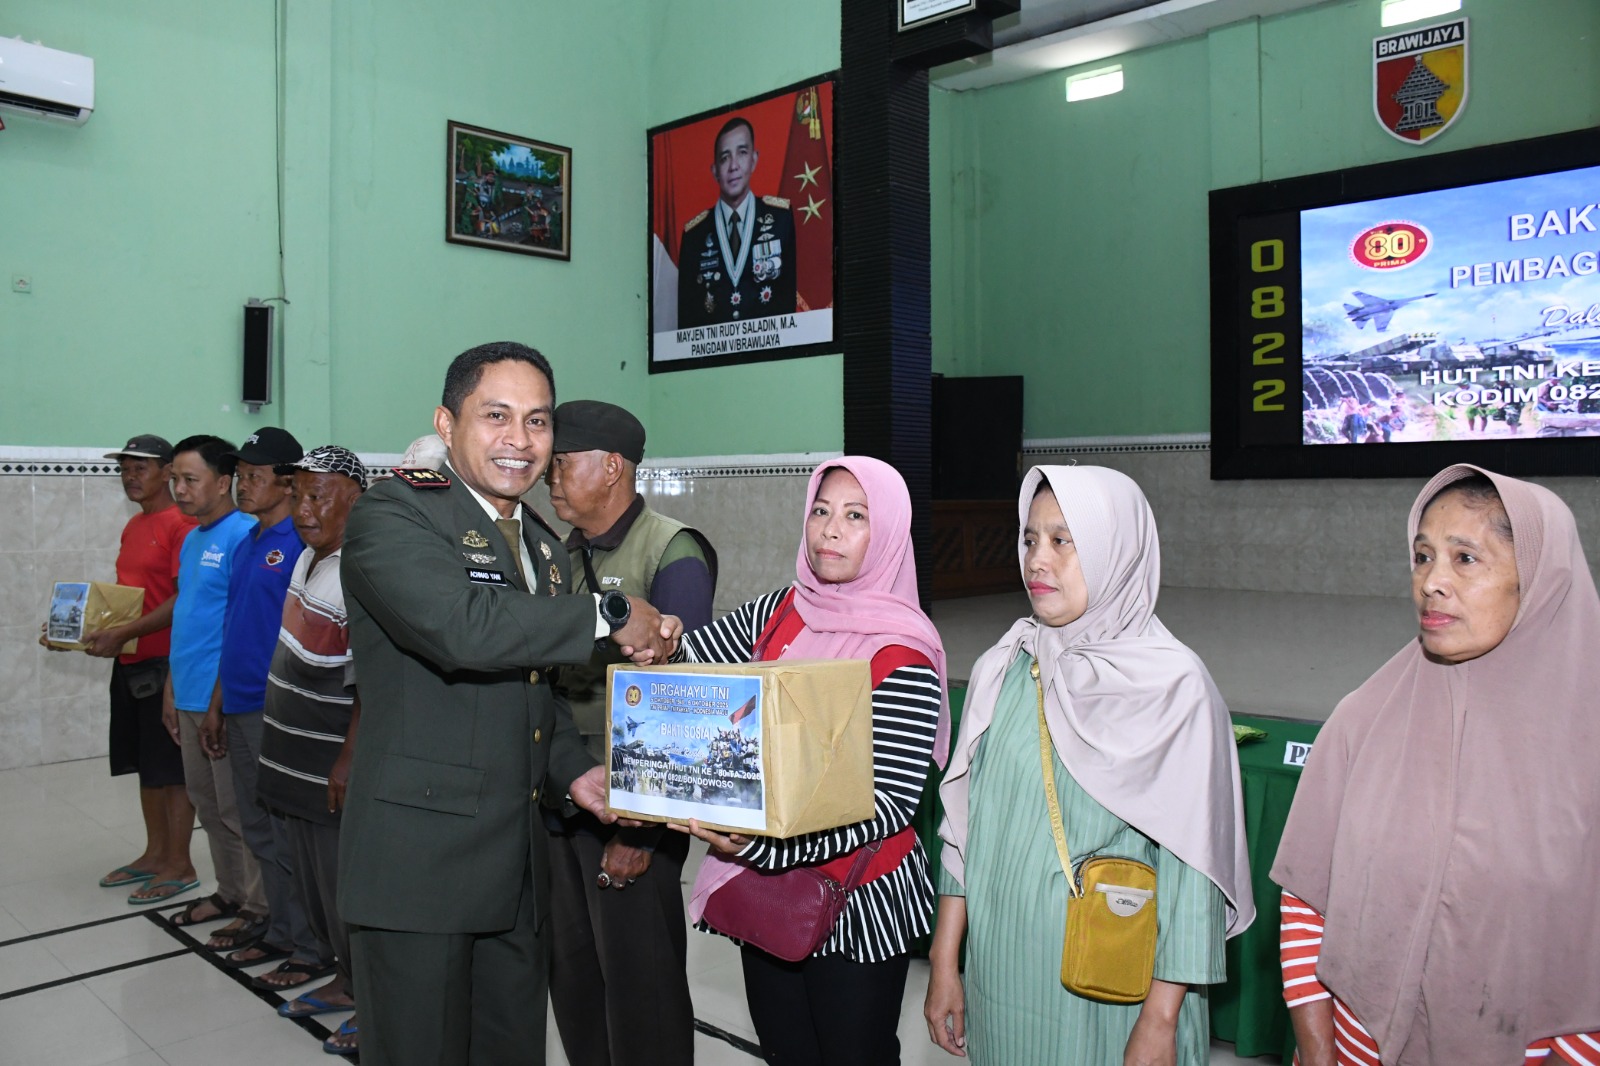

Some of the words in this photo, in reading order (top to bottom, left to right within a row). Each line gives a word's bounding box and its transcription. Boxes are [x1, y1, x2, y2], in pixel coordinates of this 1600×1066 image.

[1378, 24, 1461, 56] BRAWIJAYA
[1510, 203, 1600, 241] BAK
[1364, 229, 1415, 261] 80
[1373, 258, 1407, 268] PRIMA
[676, 328, 705, 343] MAYJEN
[706, 326, 718, 340] TNI
[719, 322, 741, 337] RUDY
[742, 318, 778, 335] SALADIN,
[780, 315, 797, 329] M.A.
[691, 339, 728, 356] PANGDAM
[729, 334, 781, 352] V/BRAWIJAYA
[1420, 366, 1484, 386] HUT
[1491, 363, 1545, 382] TNI
[1557, 360, 1600, 378] KE
[1434, 386, 1539, 407] KODIM
[650, 682, 707, 699] DIRGAHAYU
[711, 686, 729, 700] TNI
[660, 722, 683, 738] BAKTI
[683, 724, 713, 740] SOSIAL
[641, 769, 666, 780] KODIM
[688, 765, 700, 774] TNI
[701, 767, 712, 776] KE
[718, 769, 727, 777] 80
